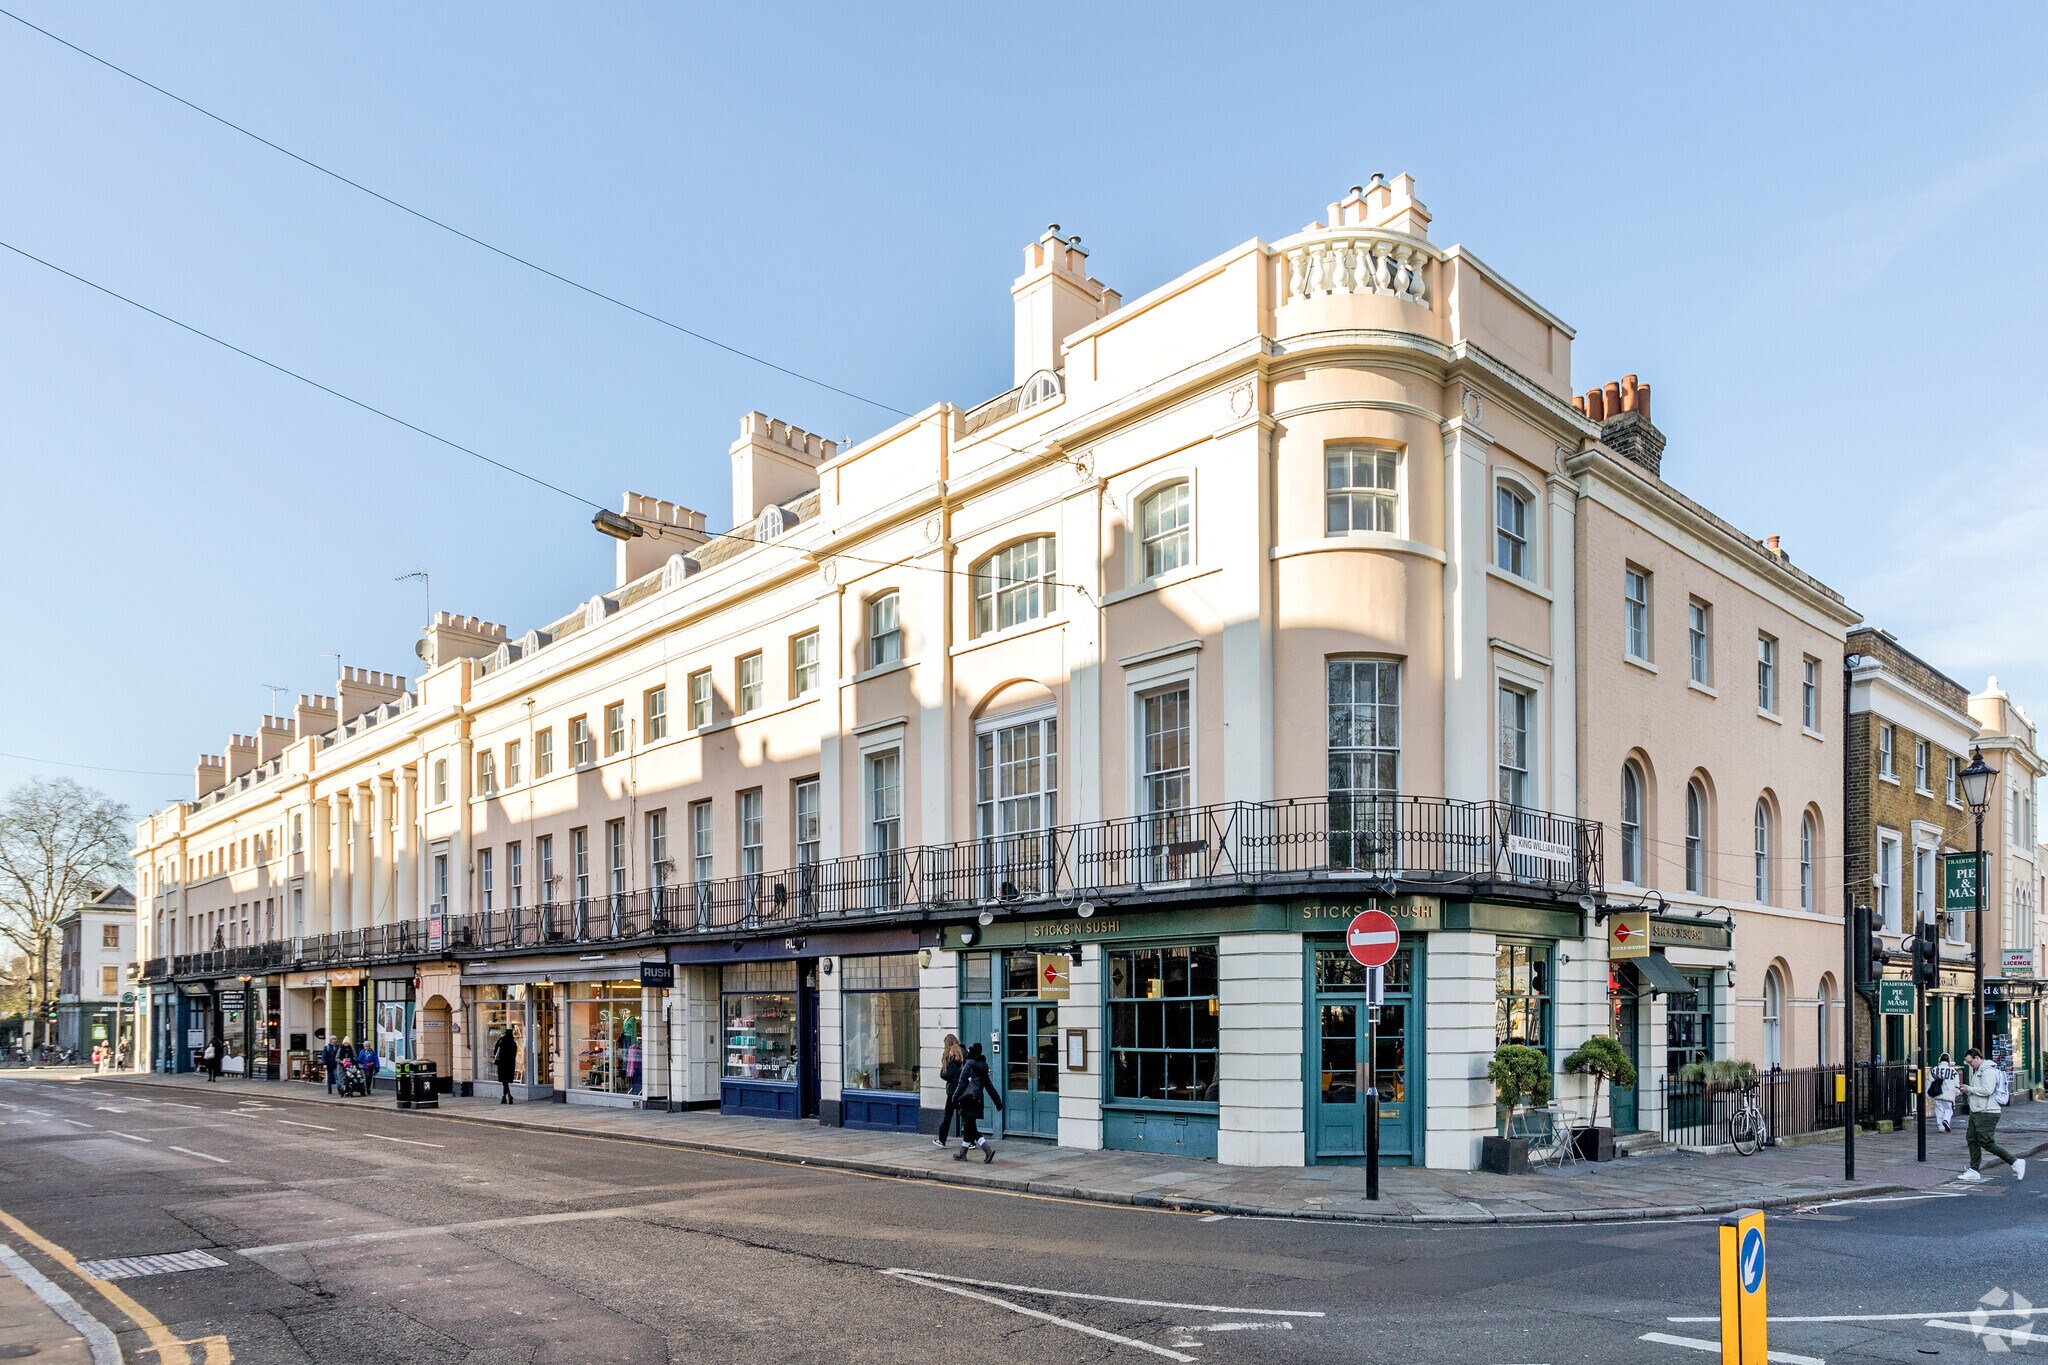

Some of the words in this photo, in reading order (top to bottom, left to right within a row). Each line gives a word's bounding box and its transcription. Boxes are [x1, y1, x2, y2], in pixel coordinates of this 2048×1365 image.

[1518, 838, 1532, 850] KING
[1532, 841, 1556, 854] WILLIAM
[1556, 845, 1571, 857] WALK
[1947, 857, 1986, 865] TRADITIONL
[1956, 868, 1976, 879] PIE
[1961, 878, 1972, 888] &
[1302, 904, 1363, 919] STICKS
[1389, 904, 1433, 919] SUSHI
[1034, 923, 1071, 937] STICKS
[1086, 920, 1120, 934] SUSHI
[785, 937, 806, 950] RU
[644, 967, 671, 978] RUSH
